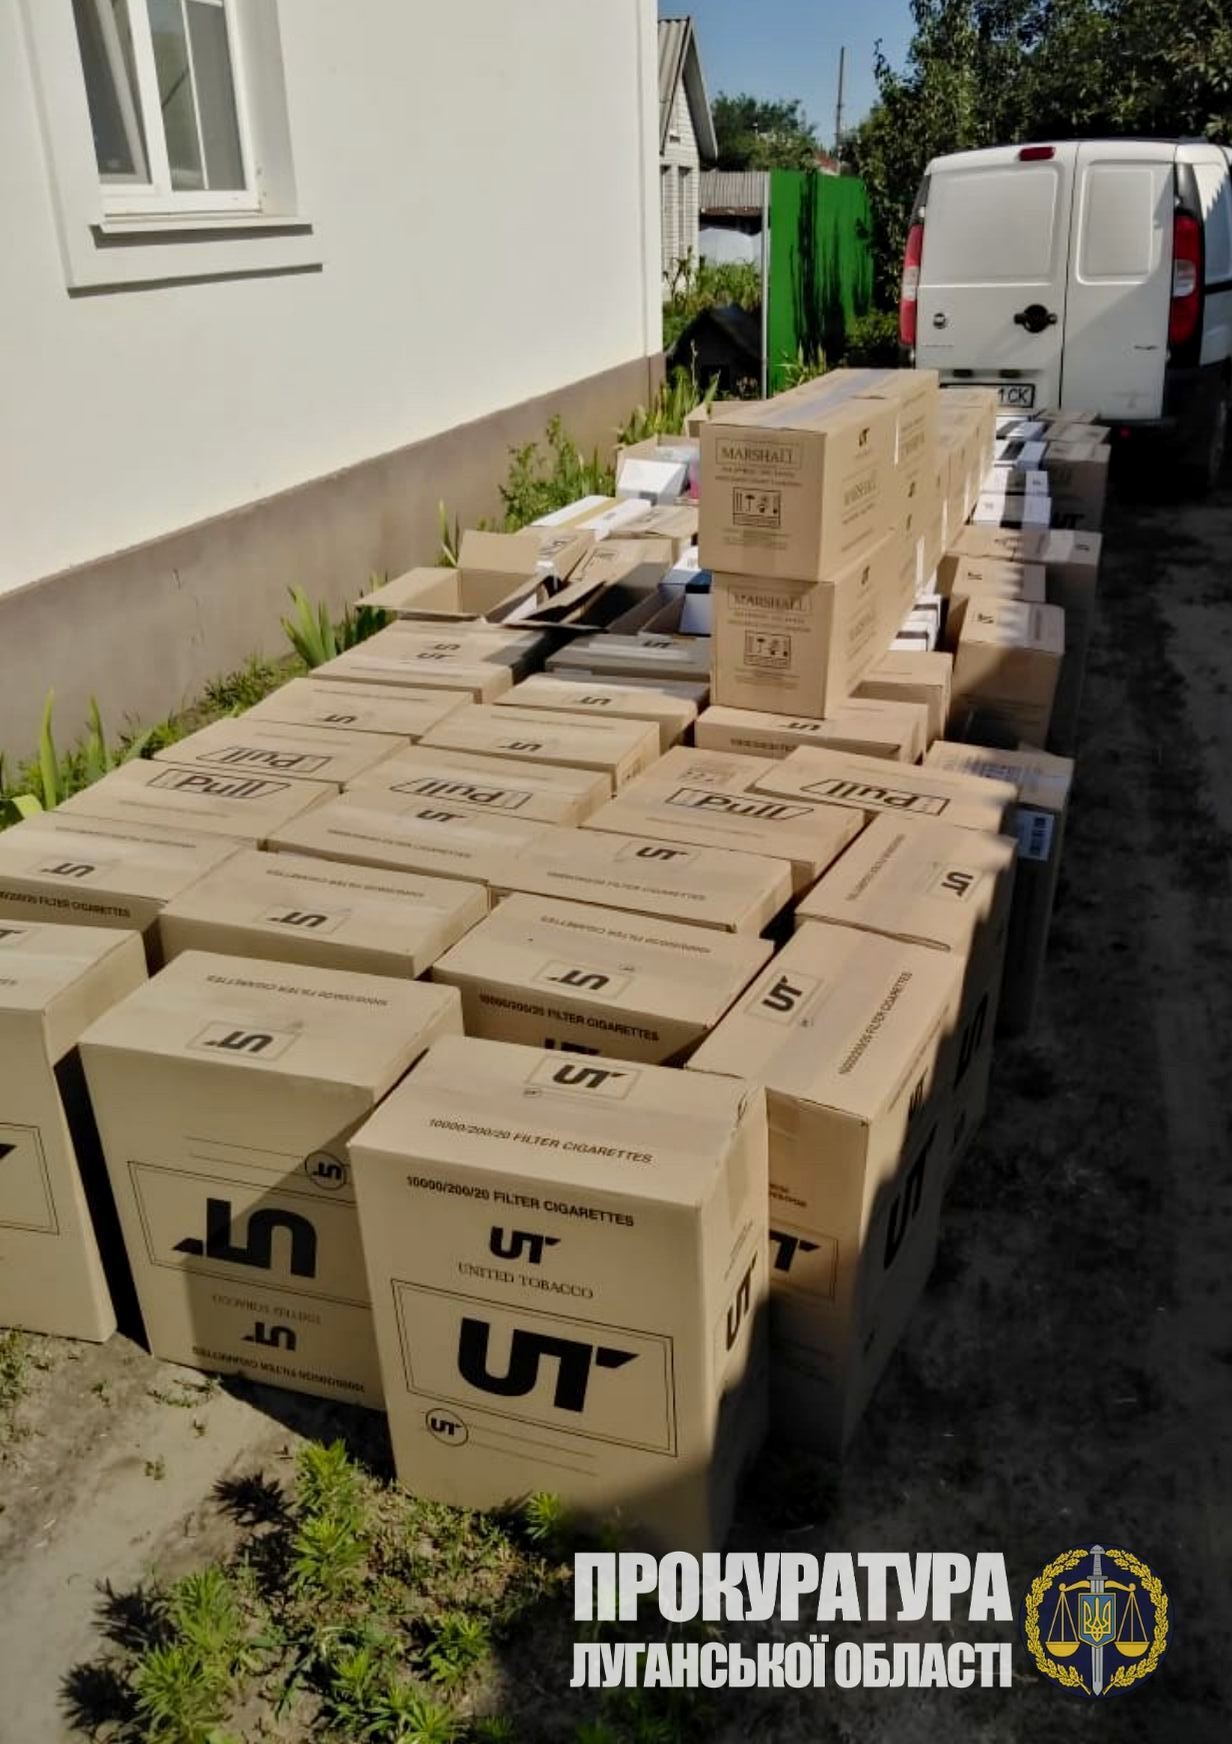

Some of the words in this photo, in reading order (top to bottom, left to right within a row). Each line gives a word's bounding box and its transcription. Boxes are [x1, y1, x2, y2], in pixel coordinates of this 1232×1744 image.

[1008, 388, 1030, 403] CK
[220, 748, 303, 768] Pull
[177, 775, 267, 796] Pull
[416, 781, 504, 801] Pull
[828, 781, 918, 807] Pull
[694, 796, 787, 817] Pull
[941, 871, 974, 897] UT
[267, 911, 328, 927] UT
[545, 969, 610, 990] UT
[762, 975, 803, 1012] UT
[202, 1031, 274, 1053] UT
[586, 1018, 661, 1042] CIGARETTES
[553, 1063, 627, 1088] UT
[513, 1132, 560, 1148] FILTER
[562, 1140, 654, 1164] CIGARETTES
[406, 1175, 490, 1201] 10000/200/20
[493, 1190, 540, 1211] FILTER
[543, 1199, 635, 1227] CIGARETTES
[172, 1198, 317, 1278] UT
[488, 1225, 562, 1264] UT
[768, 1229, 821, 1272] T
[457, 1262, 515, 1285] UNITED
[519, 1273, 595, 1299] TOBACCO
[240, 1321, 297, 1352] UT
[458, 1317, 640, 1412] UT
[430, 1417, 461, 1435] UT
